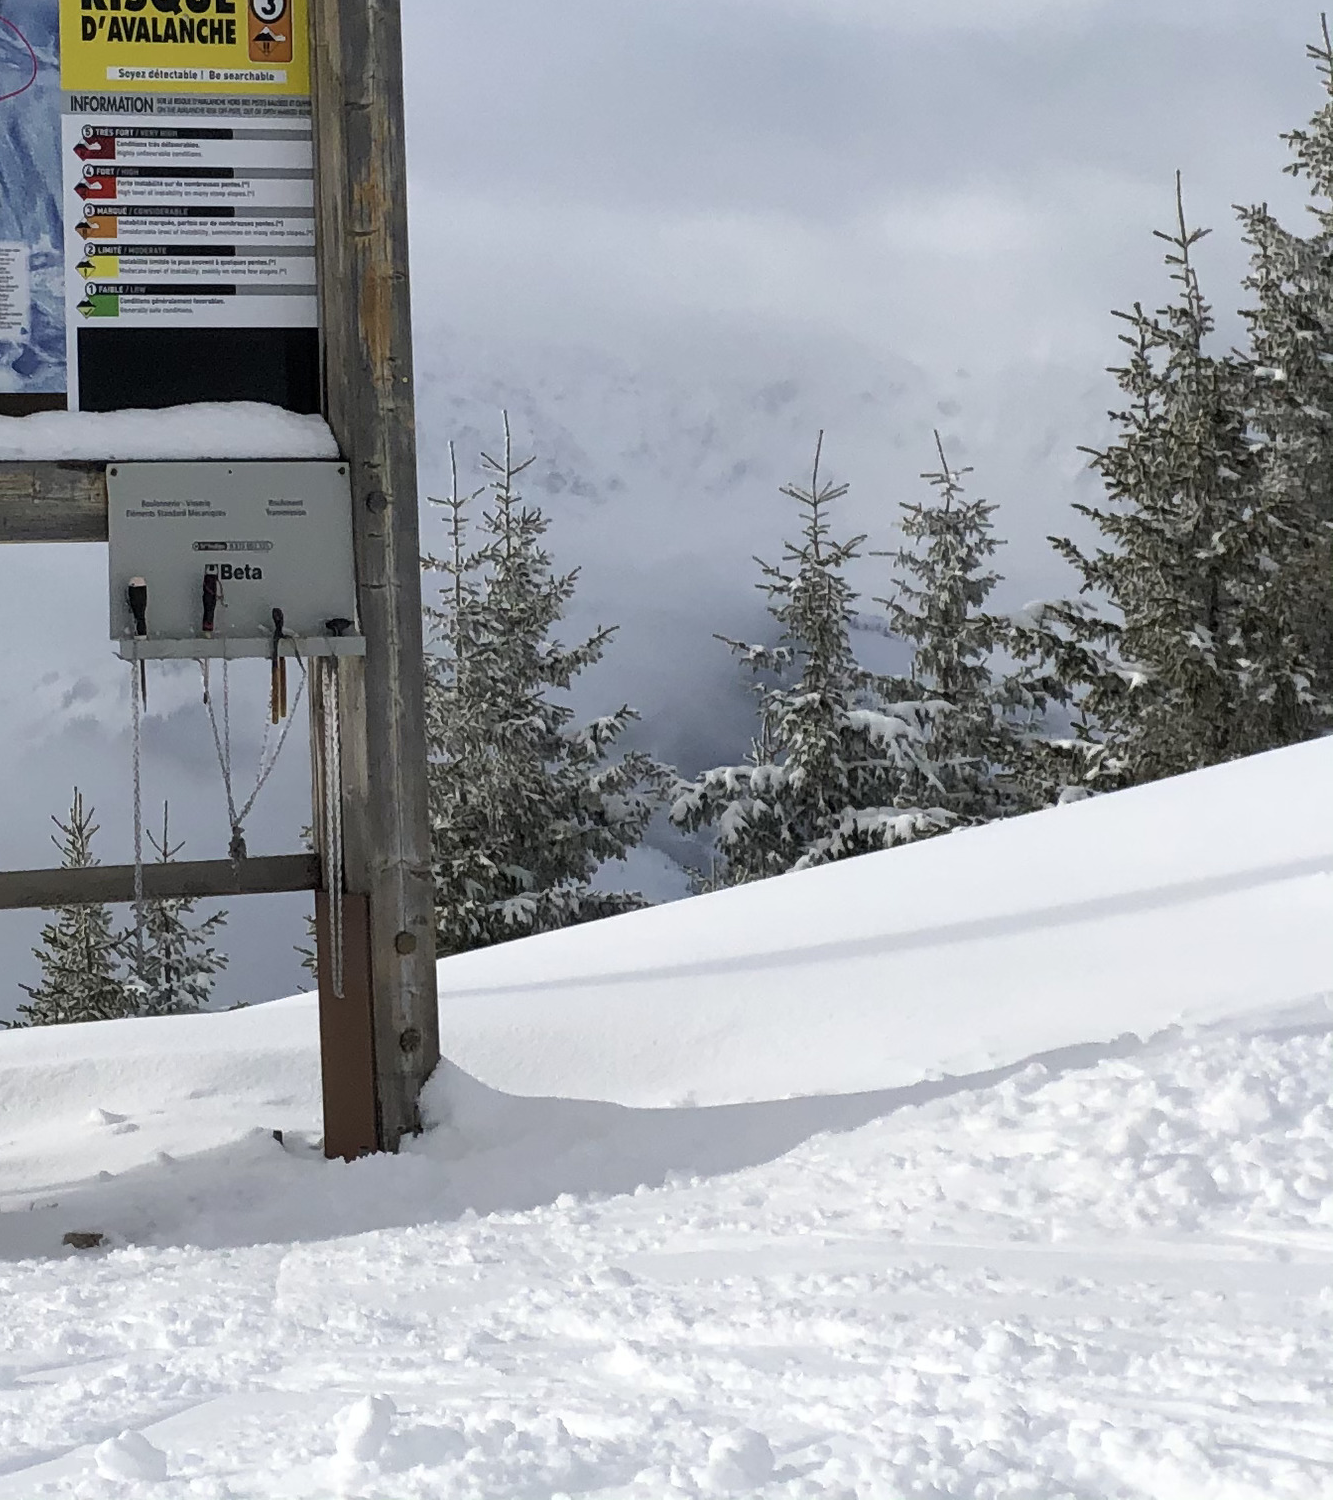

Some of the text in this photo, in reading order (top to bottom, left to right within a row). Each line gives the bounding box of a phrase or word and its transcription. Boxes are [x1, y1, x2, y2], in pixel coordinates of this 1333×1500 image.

[82, 15, 236, 45] D'AVALANCHE
[118, 68, 146, 80] Soyez
[148, 69, 198, 80] détectable
[209, 71, 221, 81] Be
[224, 71, 275, 81] searchable
[70, 95, 154, 113] INFORMATION
[220, 564, 263, 580] Beta
